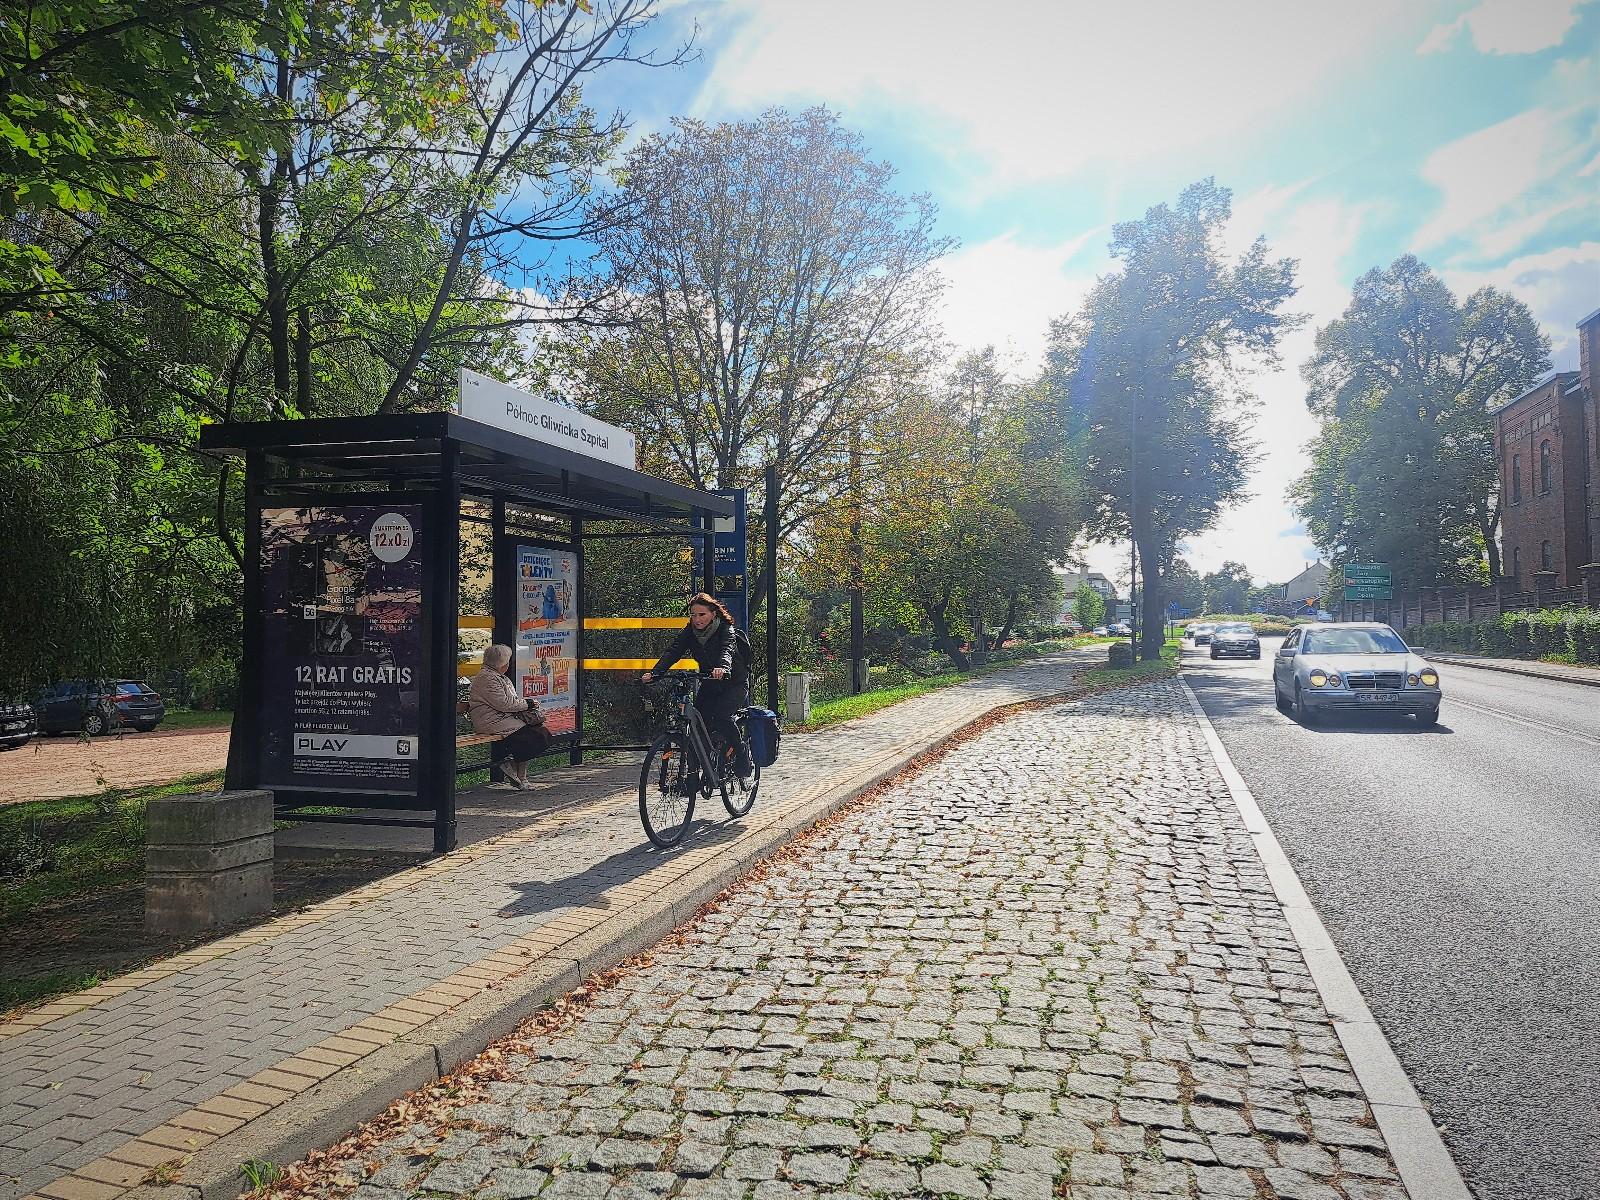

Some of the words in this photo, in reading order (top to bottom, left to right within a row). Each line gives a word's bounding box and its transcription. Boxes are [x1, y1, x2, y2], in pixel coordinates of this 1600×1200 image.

[506, 401, 539, 426] Północ
[540, 414, 579, 439] Gliwicka
[580, 428, 609, 450] Szpital
[520, 564, 553, 579] TLENTY
[326, 584, 356, 595] Google
[295, 665, 312, 683] 12
[316, 665, 348, 683] RAT
[352, 666, 412, 685] GRATIS
[298, 737, 349, 752] PLAY
[398, 742, 409, 754] 5G
